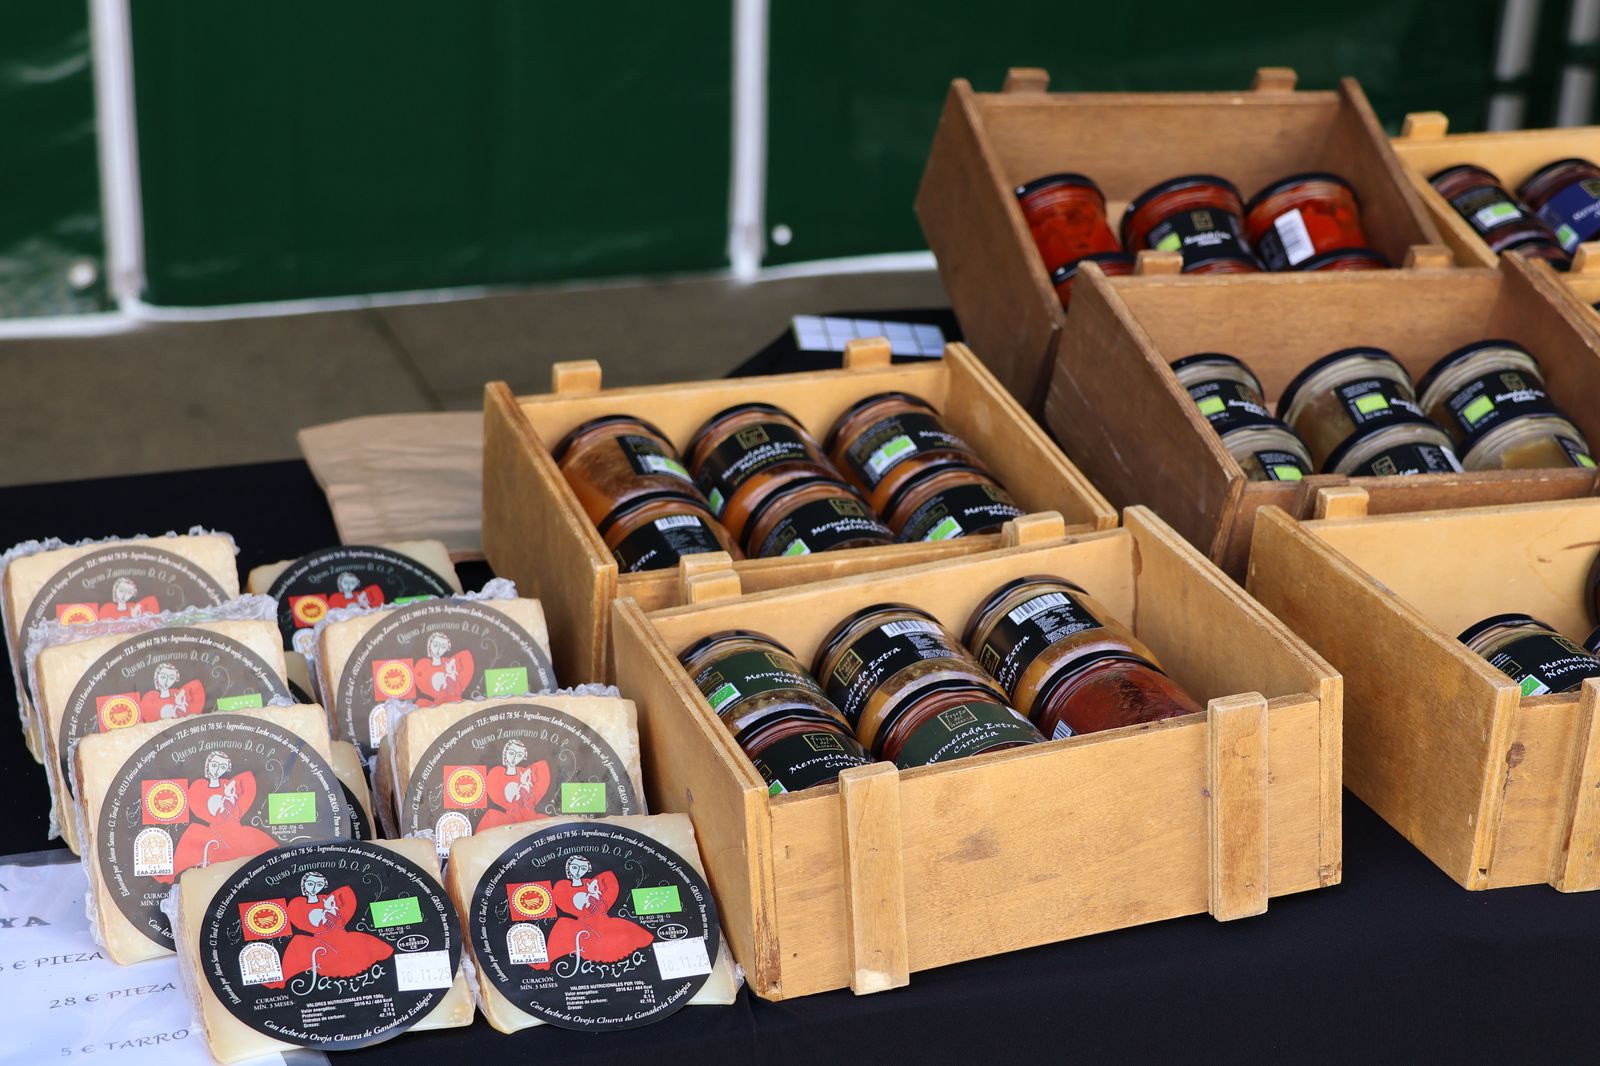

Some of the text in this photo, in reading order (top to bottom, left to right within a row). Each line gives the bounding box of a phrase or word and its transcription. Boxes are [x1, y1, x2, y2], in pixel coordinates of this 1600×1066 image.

[397, 621, 460, 644] Queso Zamorano
[868, 647, 901, 670] Extra
[1004, 635, 1030, 665] Extra
[121, 652, 188, 678] Queso Zamorano
[1539, 655, 1599, 671] Mermelad
[1544, 662, 1597, 679] Naranja
[744, 671, 804, 682] Mermelada
[1005, 662, 1019, 691] anja
[843, 670, 869, 716] melada
[849, 667, 885, 714] Naranja
[984, 722, 1020, 730] Extra
[472, 728, 539, 750] Queso Zamorano
[953, 731, 999, 754] Ciruela
[171, 746, 197, 764] Queso
[198, 740, 243, 752] Zamorano
[244, 740, 253, 752] D.
[255, 744, 265, 756] O.
[788, 754, 856, 774] Mermelada
[825, 761, 863, 769] Cirue
[531, 852, 556, 868] Queso
[557, 845, 599, 858] Zamorano
[601, 843, 610, 855] D.
[613, 846, 622, 857] O.
[265, 870, 291, 886] Queso
[291, 861, 336, 875] Zamorano
[339, 859, 348, 870] D.
[350, 861, 359, 871] O.
[491, 963, 508, 982] Elaborado
[515, 846, 532, 859] Zamora
[546, 835, 556, 843] 980
[611, 832, 624, 840] Leche
[690, 886, 703, 901] GRASO
[223, 985, 241, 1004] Elaborado
[248, 865, 265, 878] Zamora
[280, 852, 290, 860] 980
[317, 845, 347, 853] Ingredientes:
[431, 896, 444, 911] GRASO
[13, 960, 26, 970] €
[35, 951, 104, 968] PIEZA
[556, 930, 647, 980] Fariza
[245, 976, 281, 985] EAA-ZA-0023
[291, 946, 387, 996] Fariza
[522, 976, 554, 984] CURACIÓN
[50, 982, 176, 1009] 28 € PIEZA
[253, 1003, 269, 1011] MÍN.
[273, 1000, 295, 1009] MESES
[255, 994, 289, 1004] CURACIÓN
[530, 1001, 544, 1011] Con
[544, 1008, 563, 1018] leche
[573, 1016, 594, 1025] Oveja
[635, 1002, 668, 1019] Ganadería
[668, 983, 691, 1003] Ecológica
[264, 1020, 279, 1030] Con
[279, 1026, 298, 1036] leche
[310, 1034, 332, 1043] Oveja
[374, 1015, 408, 1034] Ganadería
[408, 993, 432, 1016] Ecológica
[61, 1028, 190, 1057] 5 € TARRO
